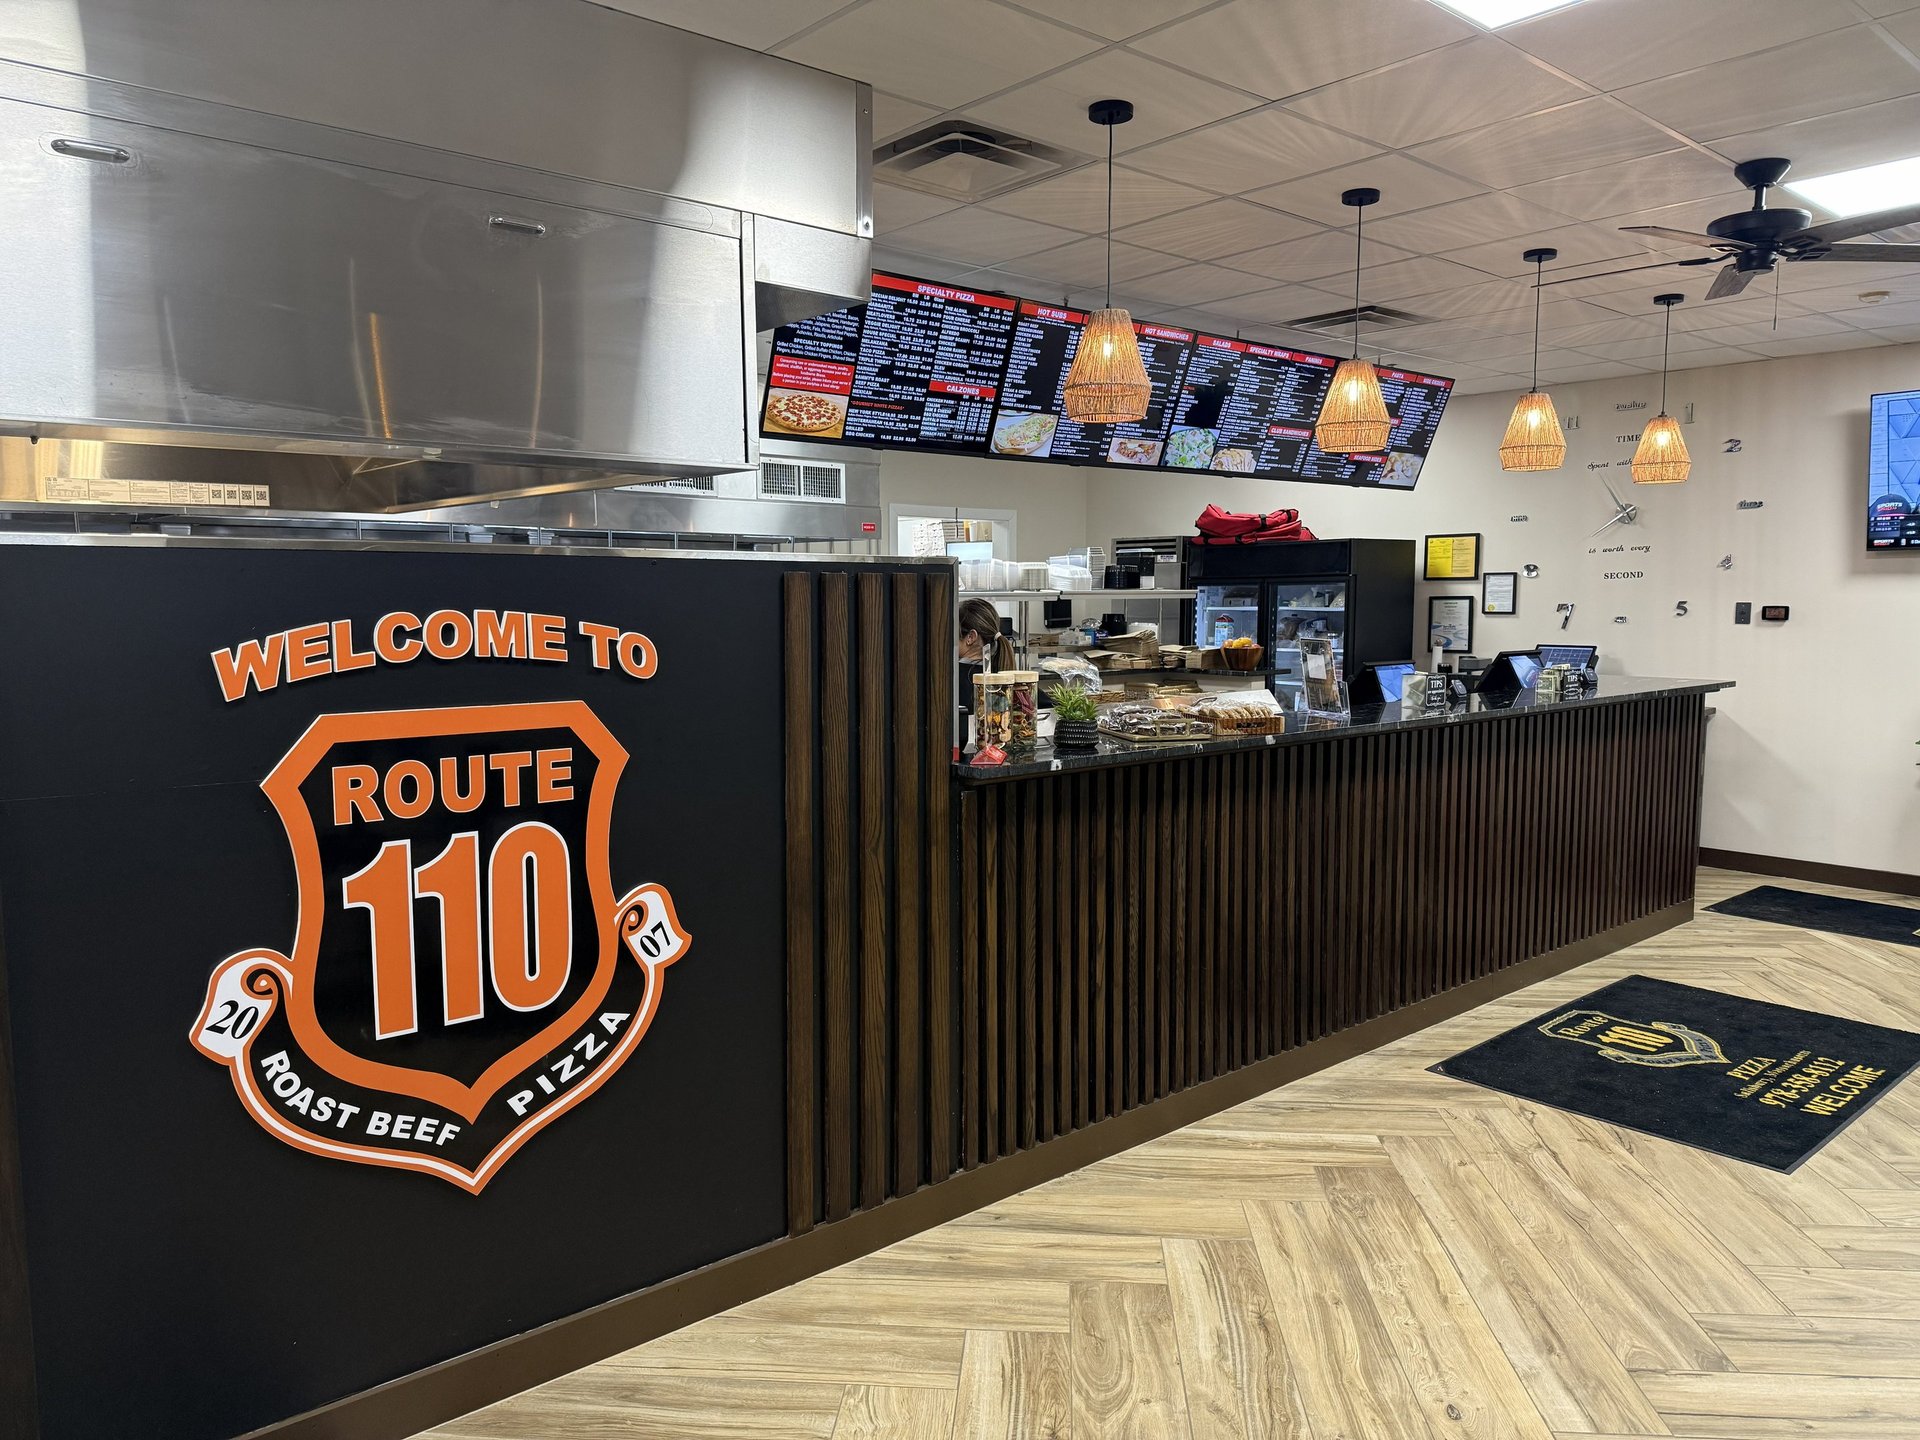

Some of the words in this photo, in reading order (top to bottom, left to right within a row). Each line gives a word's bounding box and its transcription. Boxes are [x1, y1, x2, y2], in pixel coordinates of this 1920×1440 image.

[917, 285, 955, 298] SPECIALTY
[955, 292, 975, 302] PIZZA
[867, 310, 895, 320] MEATLOVERS
[1037, 308, 1050, 316] HOT
[1051, 310, 1067, 319] SUBS
[794, 338, 819, 346] SPECIALTY
[1145, 327, 1156, 335] HOT
[1157, 329, 1189, 340] SANDWICHES
[1213, 340, 1231, 348] SALADS
[1249, 346, 1273, 356] SPECIALTY
[947, 385, 980, 395] CALZONES
[1616, 434, 1641, 443] TIME
[1723, 438, 1742, 453] 2
[1587, 461, 1609, 471] Spent
[1602, 545, 1625, 553] worth
[1604, 571, 1644, 580] SECOND
[1556, 603, 1575, 630] 7
[1675, 600, 1688, 617] 5
[211, 609, 569, 701] WELCOME
[578, 620, 659, 680] TO
[1430, 680, 1443, 689] TIPS
[331, 747, 575, 826] ROUTE
[342, 820, 574, 1041] 110
[639, 925, 674, 958] 07
[205, 1000, 260, 1040] 20
[1557, 1016, 1609, 1038] Route
[1597, 1025, 1674, 1052] 110
[506, 1009, 631, 1117] PIZZA
[1726, 1056, 1777, 1081] PIZZA
[1758, 1056, 1846, 1109] 978-358-8112
[1800, 1064, 1887, 1116] WELCOME
[260, 1050, 361, 1130] ROAST
[365, 1111, 461, 1147] BEEF
